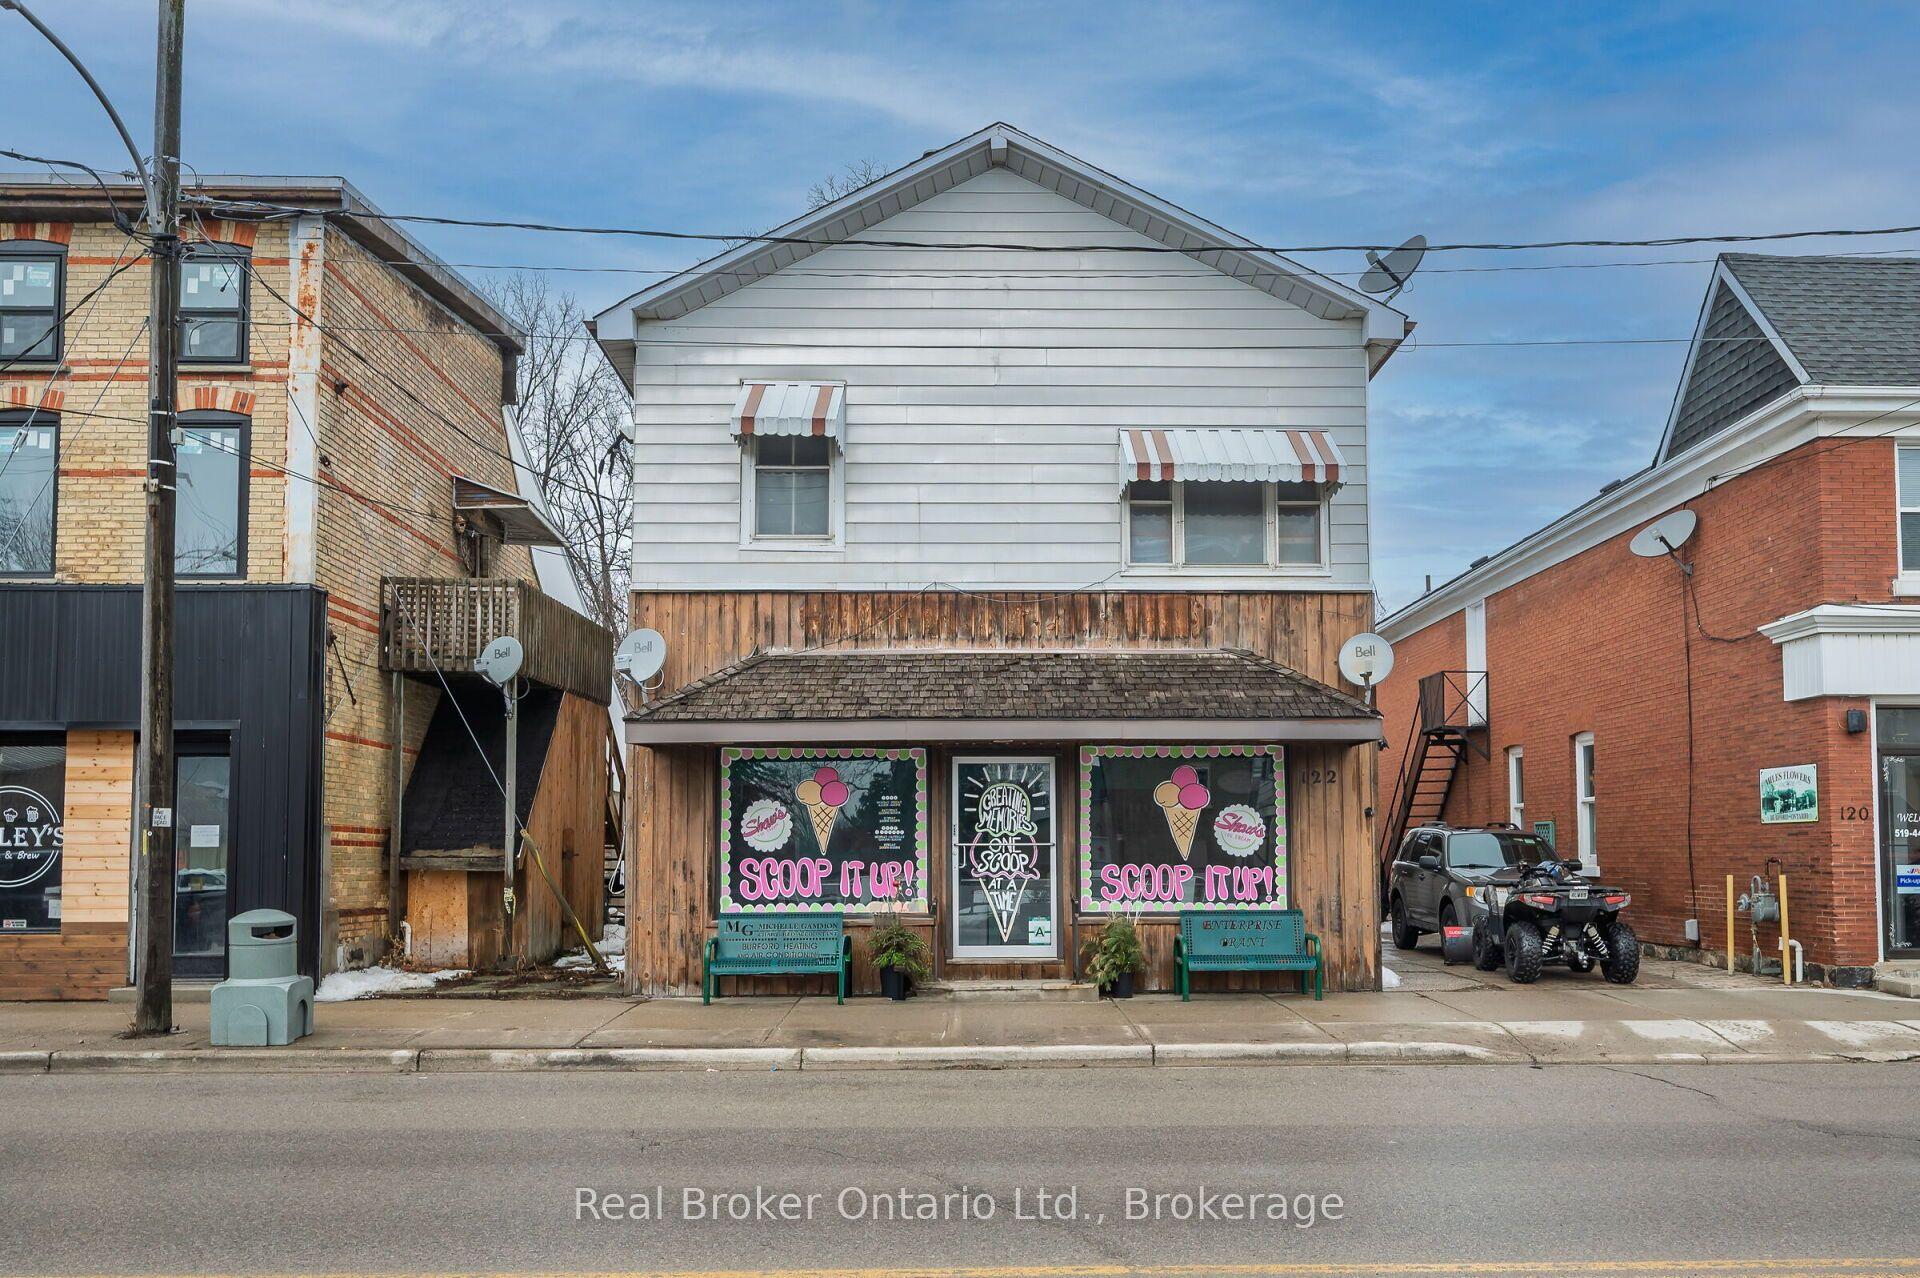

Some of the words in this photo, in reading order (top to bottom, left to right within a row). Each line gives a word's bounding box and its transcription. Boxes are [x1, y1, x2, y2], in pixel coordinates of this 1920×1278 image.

[494, 647, 511, 660] Bell
[634, 641, 653, 654] Bell
[1355, 644, 1376, 658] Bell
[1301, 769, 1337, 784] 122
[982, 786, 1027, 815] CREATING
[978, 806, 1032, 833] MEMORIES
[1840, 806, 1869, 821] 120
[742, 806, 788, 838] Shaw's
[1214, 812, 1265, 838] Shaw's
[988, 837, 1022, 853] ONE
[4, 850, 13, 860] &
[17, 850, 40, 860] Brew
[978, 850, 1029, 873] SCOOP
[739, 857, 832, 900] SCOOP
[840, 860, 865, 899] IT
[869, 860, 914, 898] UP!
[988, 877, 1004, 890] AT
[1006, 878, 1017, 891] A
[1100, 863, 1194, 901] SCOOP
[1205, 864, 1232, 901] IT
[1232, 865, 1274, 902] UP!
[989, 891, 1018, 911] TIME
[800, 922, 838, 930] GAMMON
[1035, 926, 1045, 937] A
[1203, 919, 1283, 931] ENTERPRISE
[742, 942, 780, 950] BURFORD
[783, 942, 818, 950] HEATING
